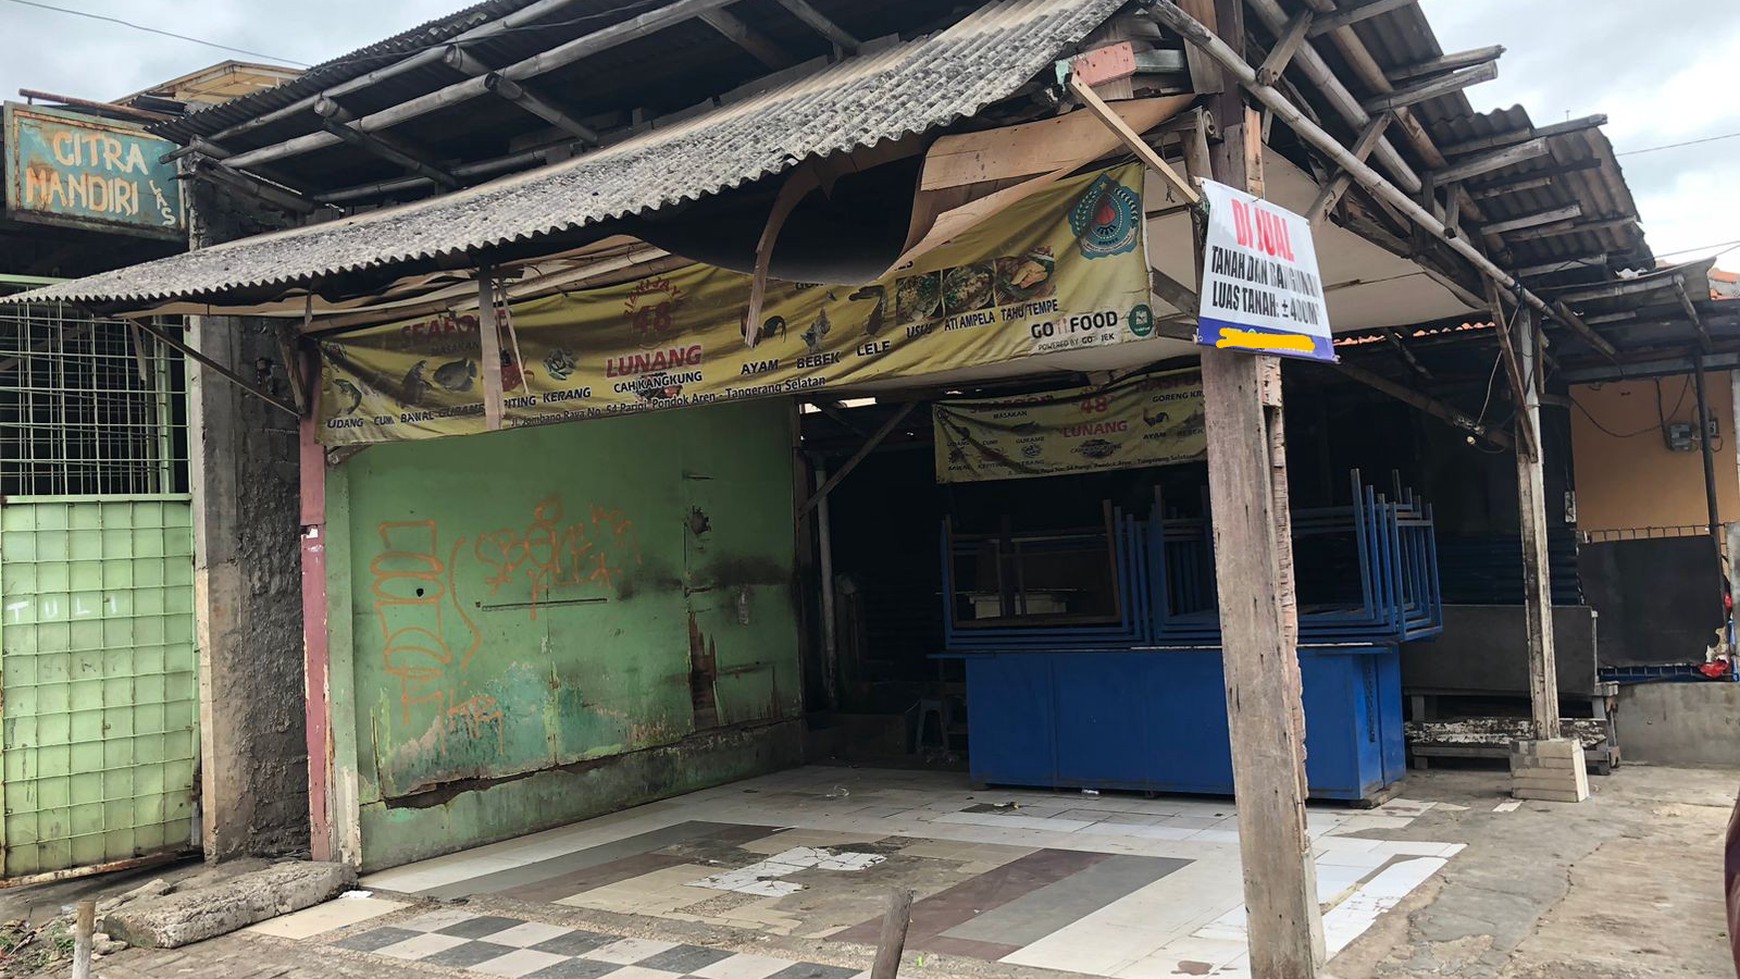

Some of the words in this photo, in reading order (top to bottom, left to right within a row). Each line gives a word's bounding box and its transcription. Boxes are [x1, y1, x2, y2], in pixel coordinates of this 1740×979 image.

[52, 131, 149, 175] CITRA
[26, 166, 139, 216] MANDIRI
[148, 179, 176, 226] LAS
[1231, 198, 1254, 248] DI
[1254, 207, 1295, 262] JUAL
[1211, 245, 1246, 280] TANAH
[1246, 256, 1268, 285] DAN
[1212, 281, 1240, 311] LUAS
[1242, 287, 1280, 318] TANAH:
[906, 325, 934, 338] USUS
[944, 319, 959, 332] ATI
[959, 311, 996, 328] AMPELA
[1000, 298, 1059, 321] TAHU/TEMPE
[606, 345, 701, 378] LUNANG
[740, 359, 780, 375] AYAM
[796, 352, 841, 369] BEBEK
[856, 340, 891, 357] LELE
[1038, 340, 1069, 352] POWERED
[1070, 338, 1079, 349] BY
[606, 403, 618, 415] 54
[652, 394, 689, 409] Pondok
[692, 393, 716, 404] Aren
[725, 382, 782, 398] Tangerang
[784, 376, 826, 391] Selatan
[613, 381, 637, 393] CAH
[637, 371, 703, 391] KANGKUNG
[1152, 391, 1189, 403] GORENG
[327, 418, 364, 429] UDANG
[400, 410, 434, 423] BAWAL
[543, 387, 592, 403] KERANG
[1081, 397, 1108, 414] 48
[1063, 420, 1128, 438] LUNANG
[1143, 431, 1167, 440] AYAM
[7, 594, 118, 623] TULI
